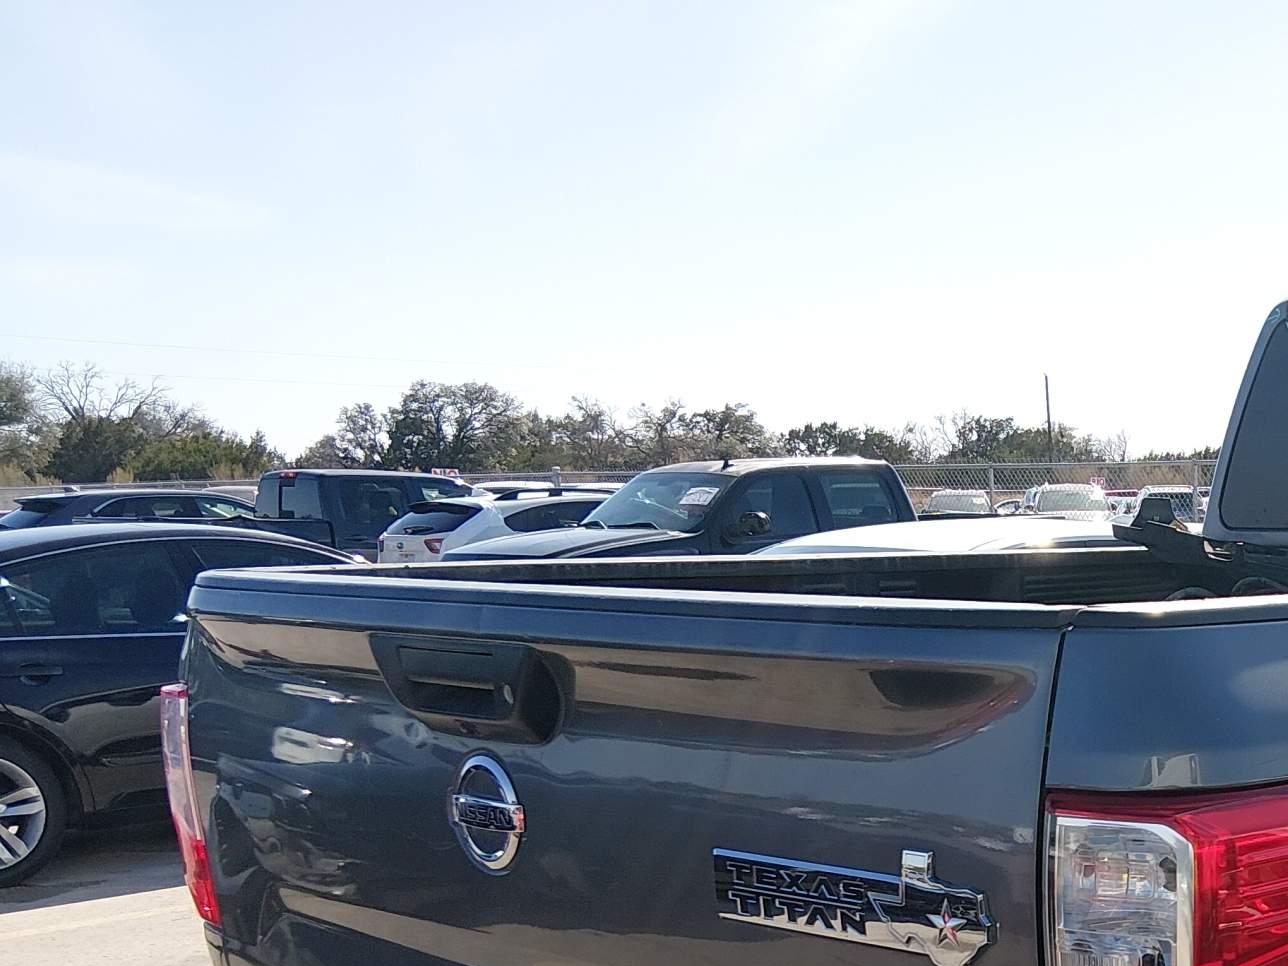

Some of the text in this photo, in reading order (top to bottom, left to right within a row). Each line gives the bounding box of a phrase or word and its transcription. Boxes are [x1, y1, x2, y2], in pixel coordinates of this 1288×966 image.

[456, 801, 513, 827] NISSAN
[727, 861, 866, 902] TEXAS
[728, 890, 867, 936] TITAN
